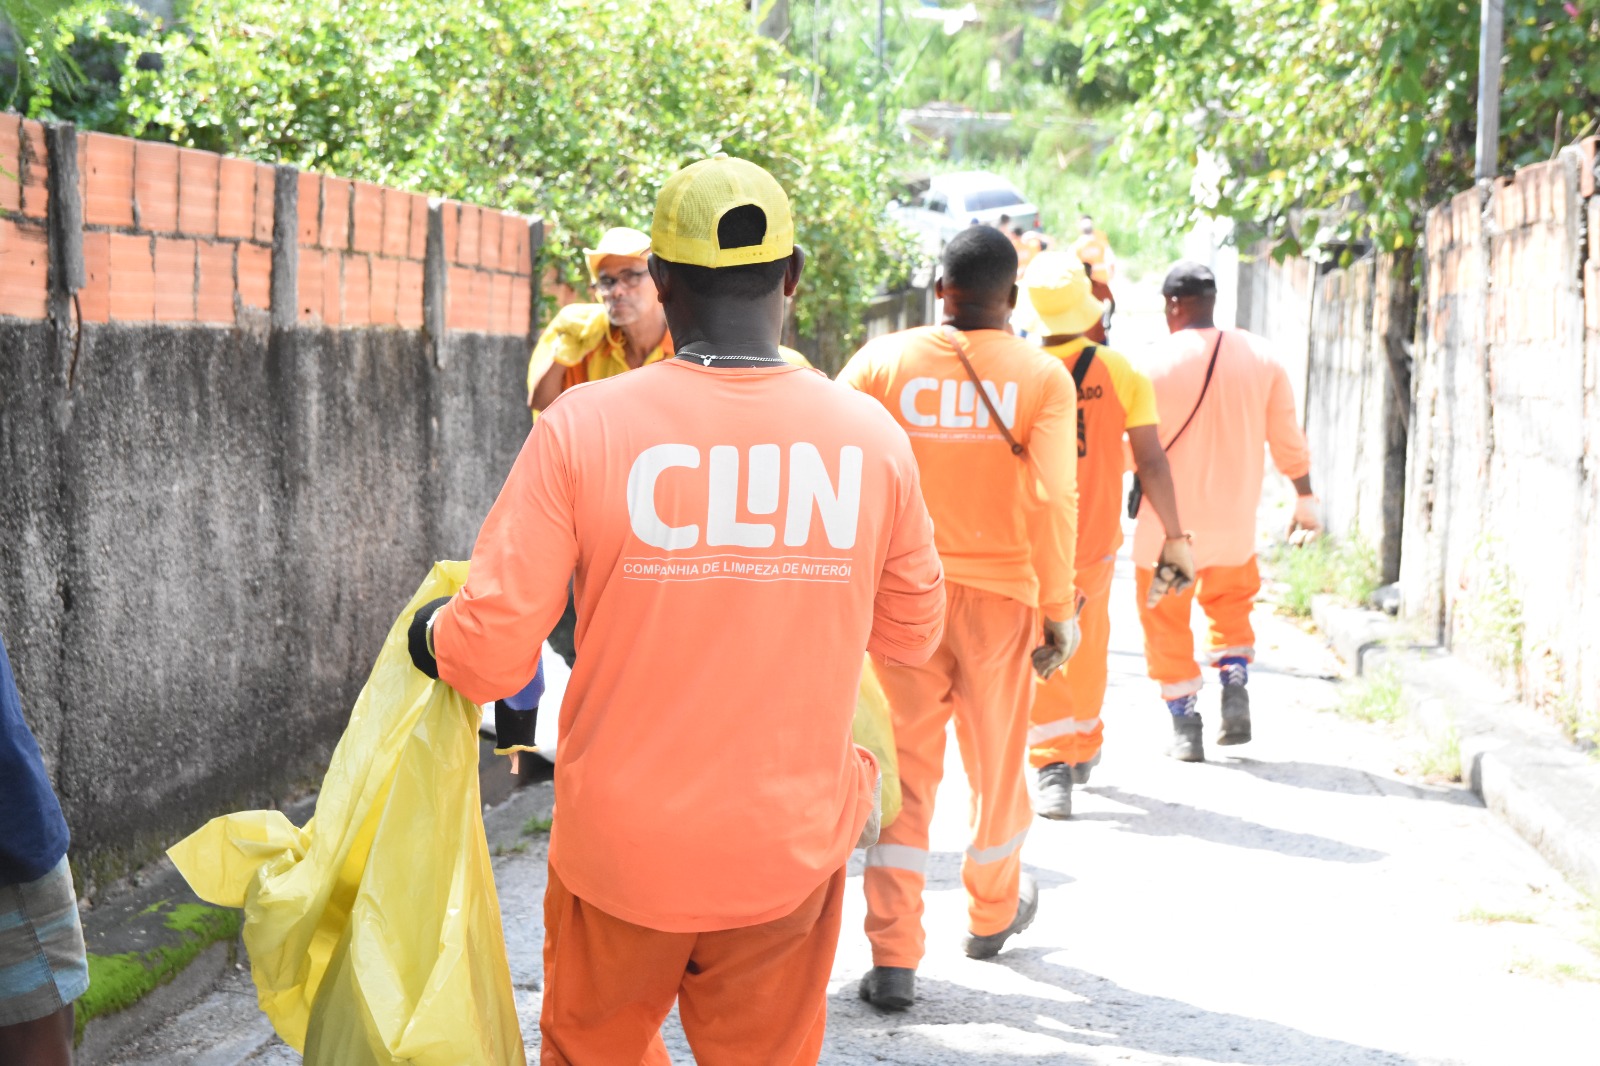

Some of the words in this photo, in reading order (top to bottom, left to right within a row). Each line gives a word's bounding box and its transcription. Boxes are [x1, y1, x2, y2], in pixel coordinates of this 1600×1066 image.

[900, 376, 1018, 430] CLIN
[626, 441, 864, 551] CLIN
[623, 562, 699, 576] COMPANHIA
[702, 561, 720, 573] DE
[723, 560, 780, 576] LIMPEZA
[782, 562, 799, 574] DE
[801, 562, 852, 577] NITERÓI
